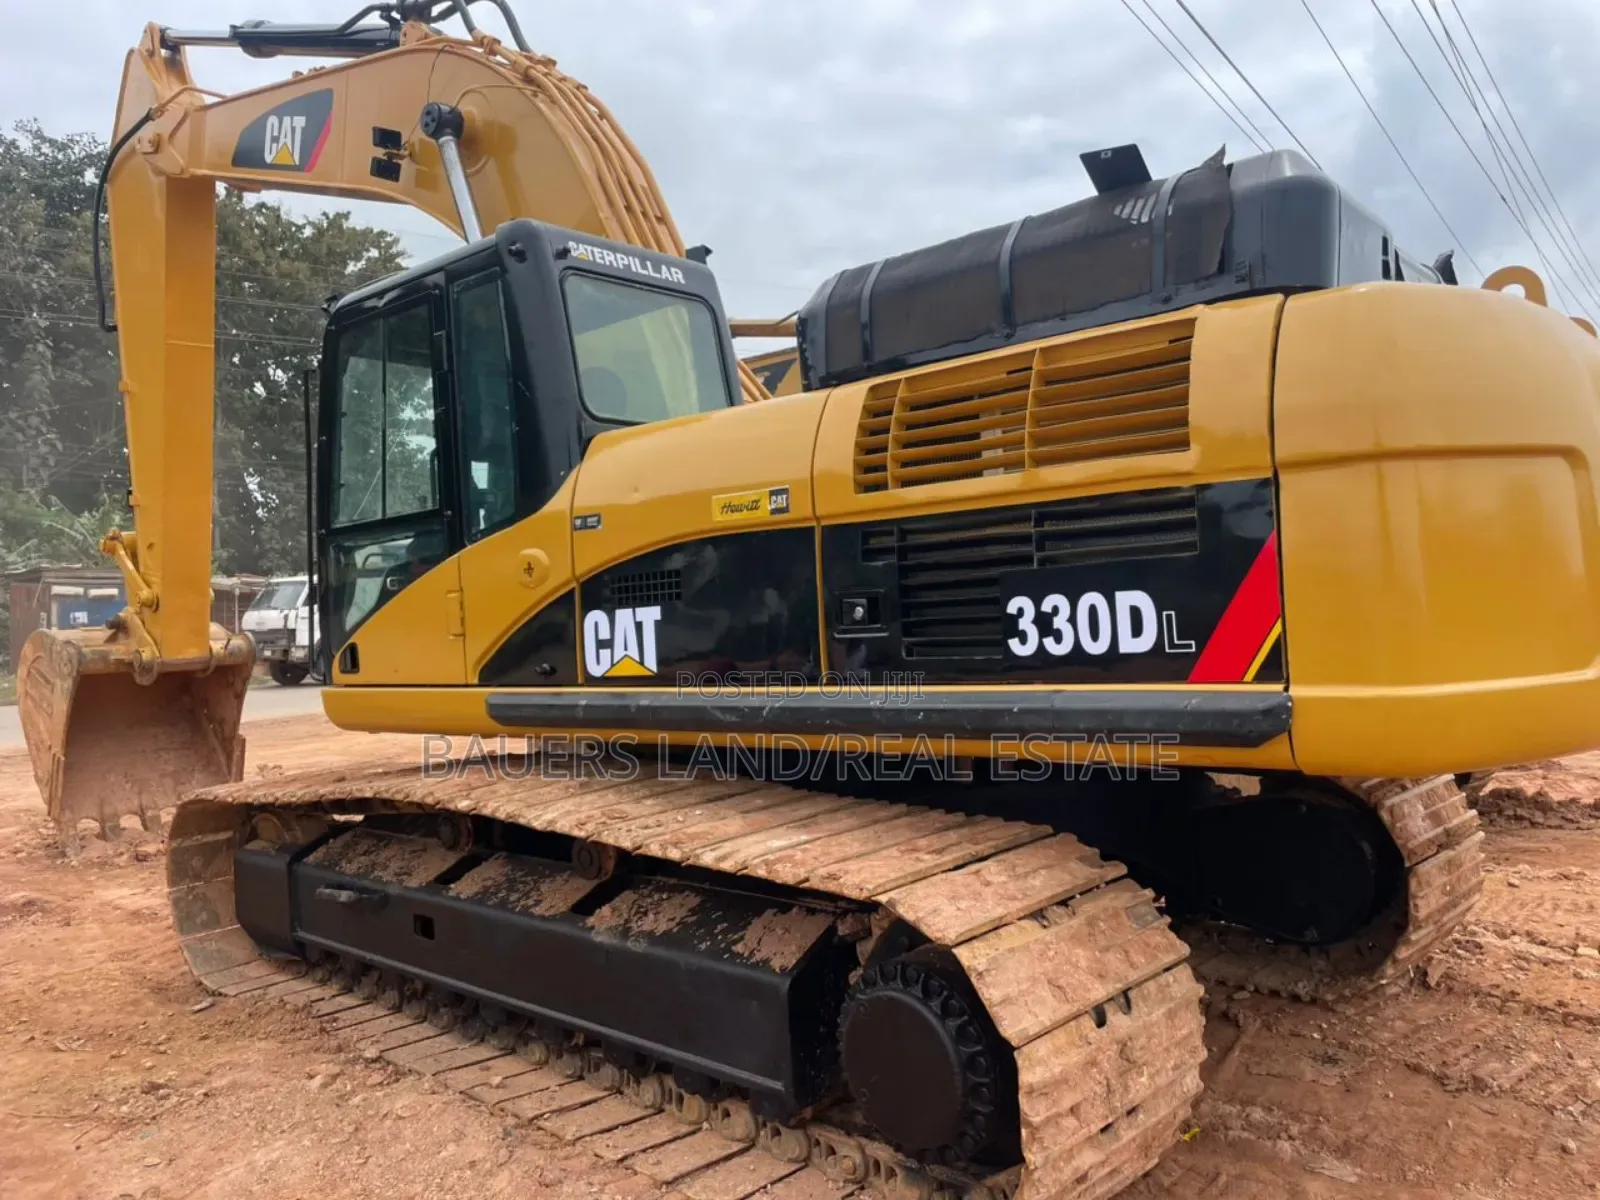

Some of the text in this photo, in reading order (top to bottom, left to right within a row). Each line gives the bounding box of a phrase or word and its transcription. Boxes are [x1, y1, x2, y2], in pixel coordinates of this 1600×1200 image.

[264, 115, 306, 165] CAT
[568, 241, 685, 284] CATERPILLAR
[770, 494, 788, 509] CAT
[583, 605, 662, 677] CAT
